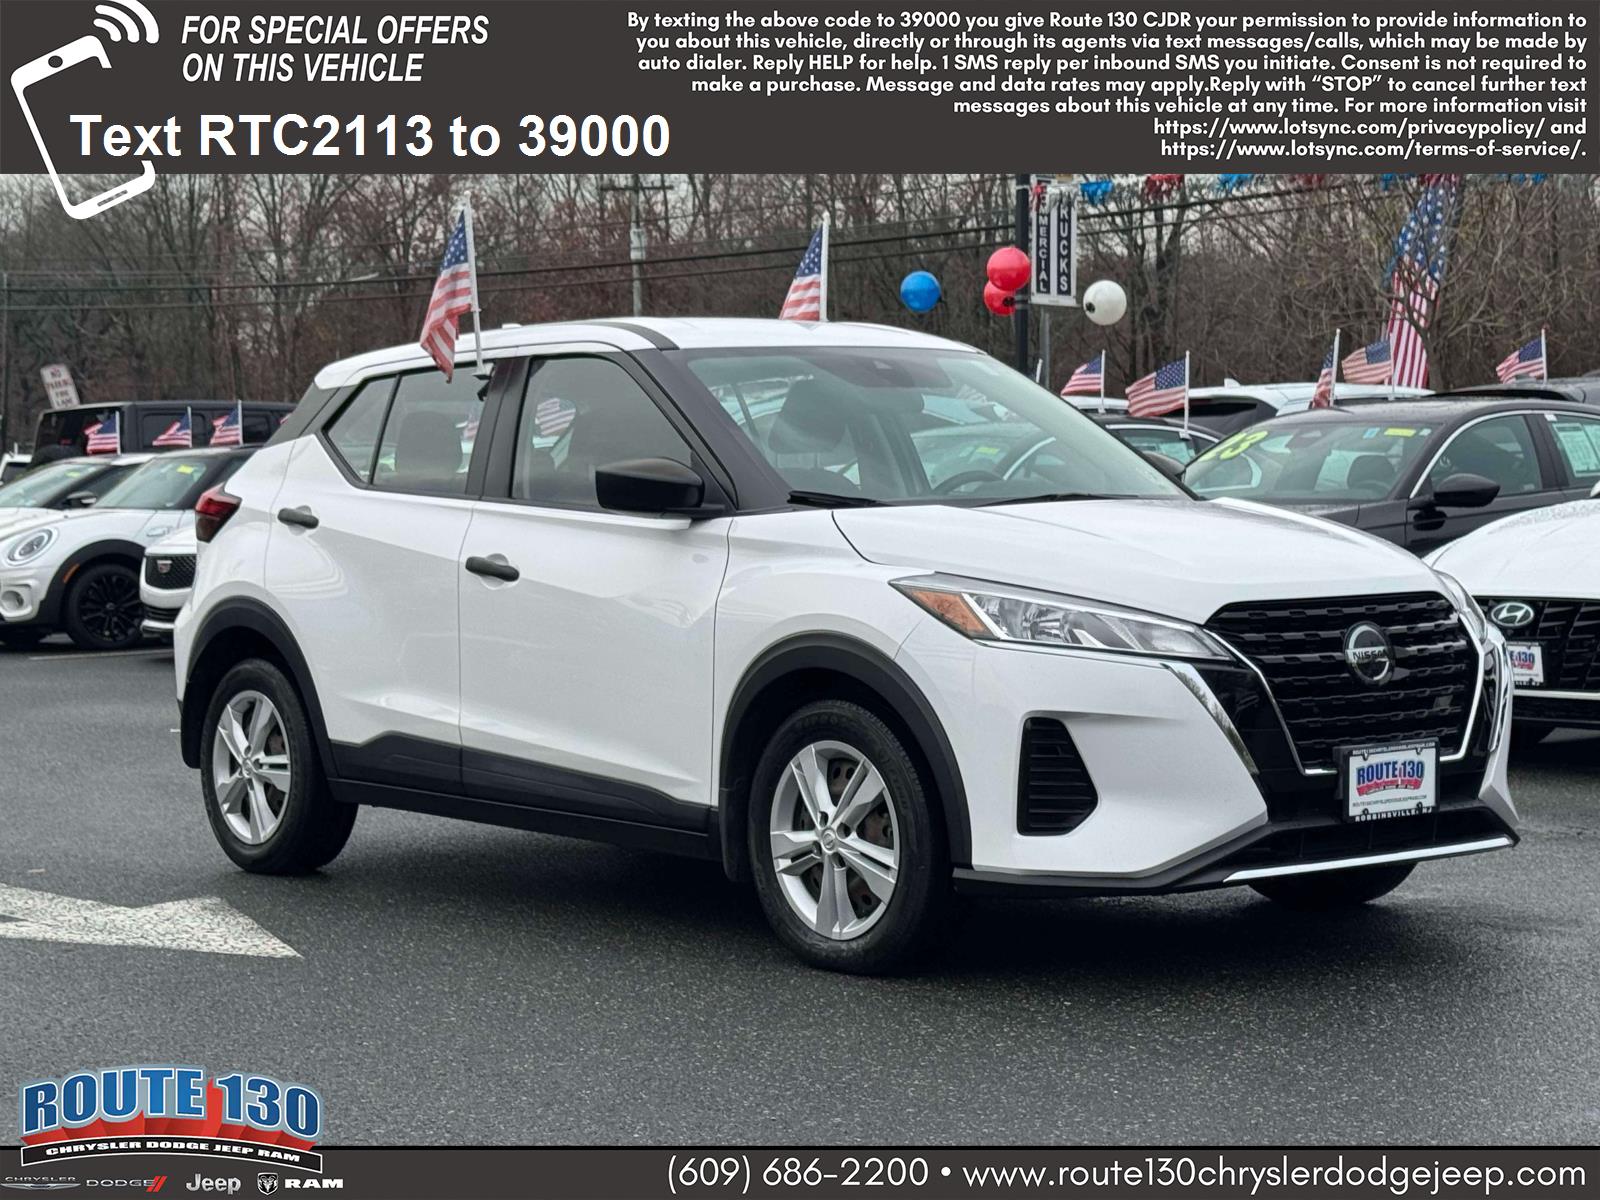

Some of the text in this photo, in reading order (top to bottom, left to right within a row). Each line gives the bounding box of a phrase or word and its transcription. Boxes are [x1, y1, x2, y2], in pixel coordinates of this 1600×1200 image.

[1059, 196, 1069, 292] RUCKS
[1517, 650, 1535, 664] 130
[1356, 760, 1425, 786] ROUTE 130
